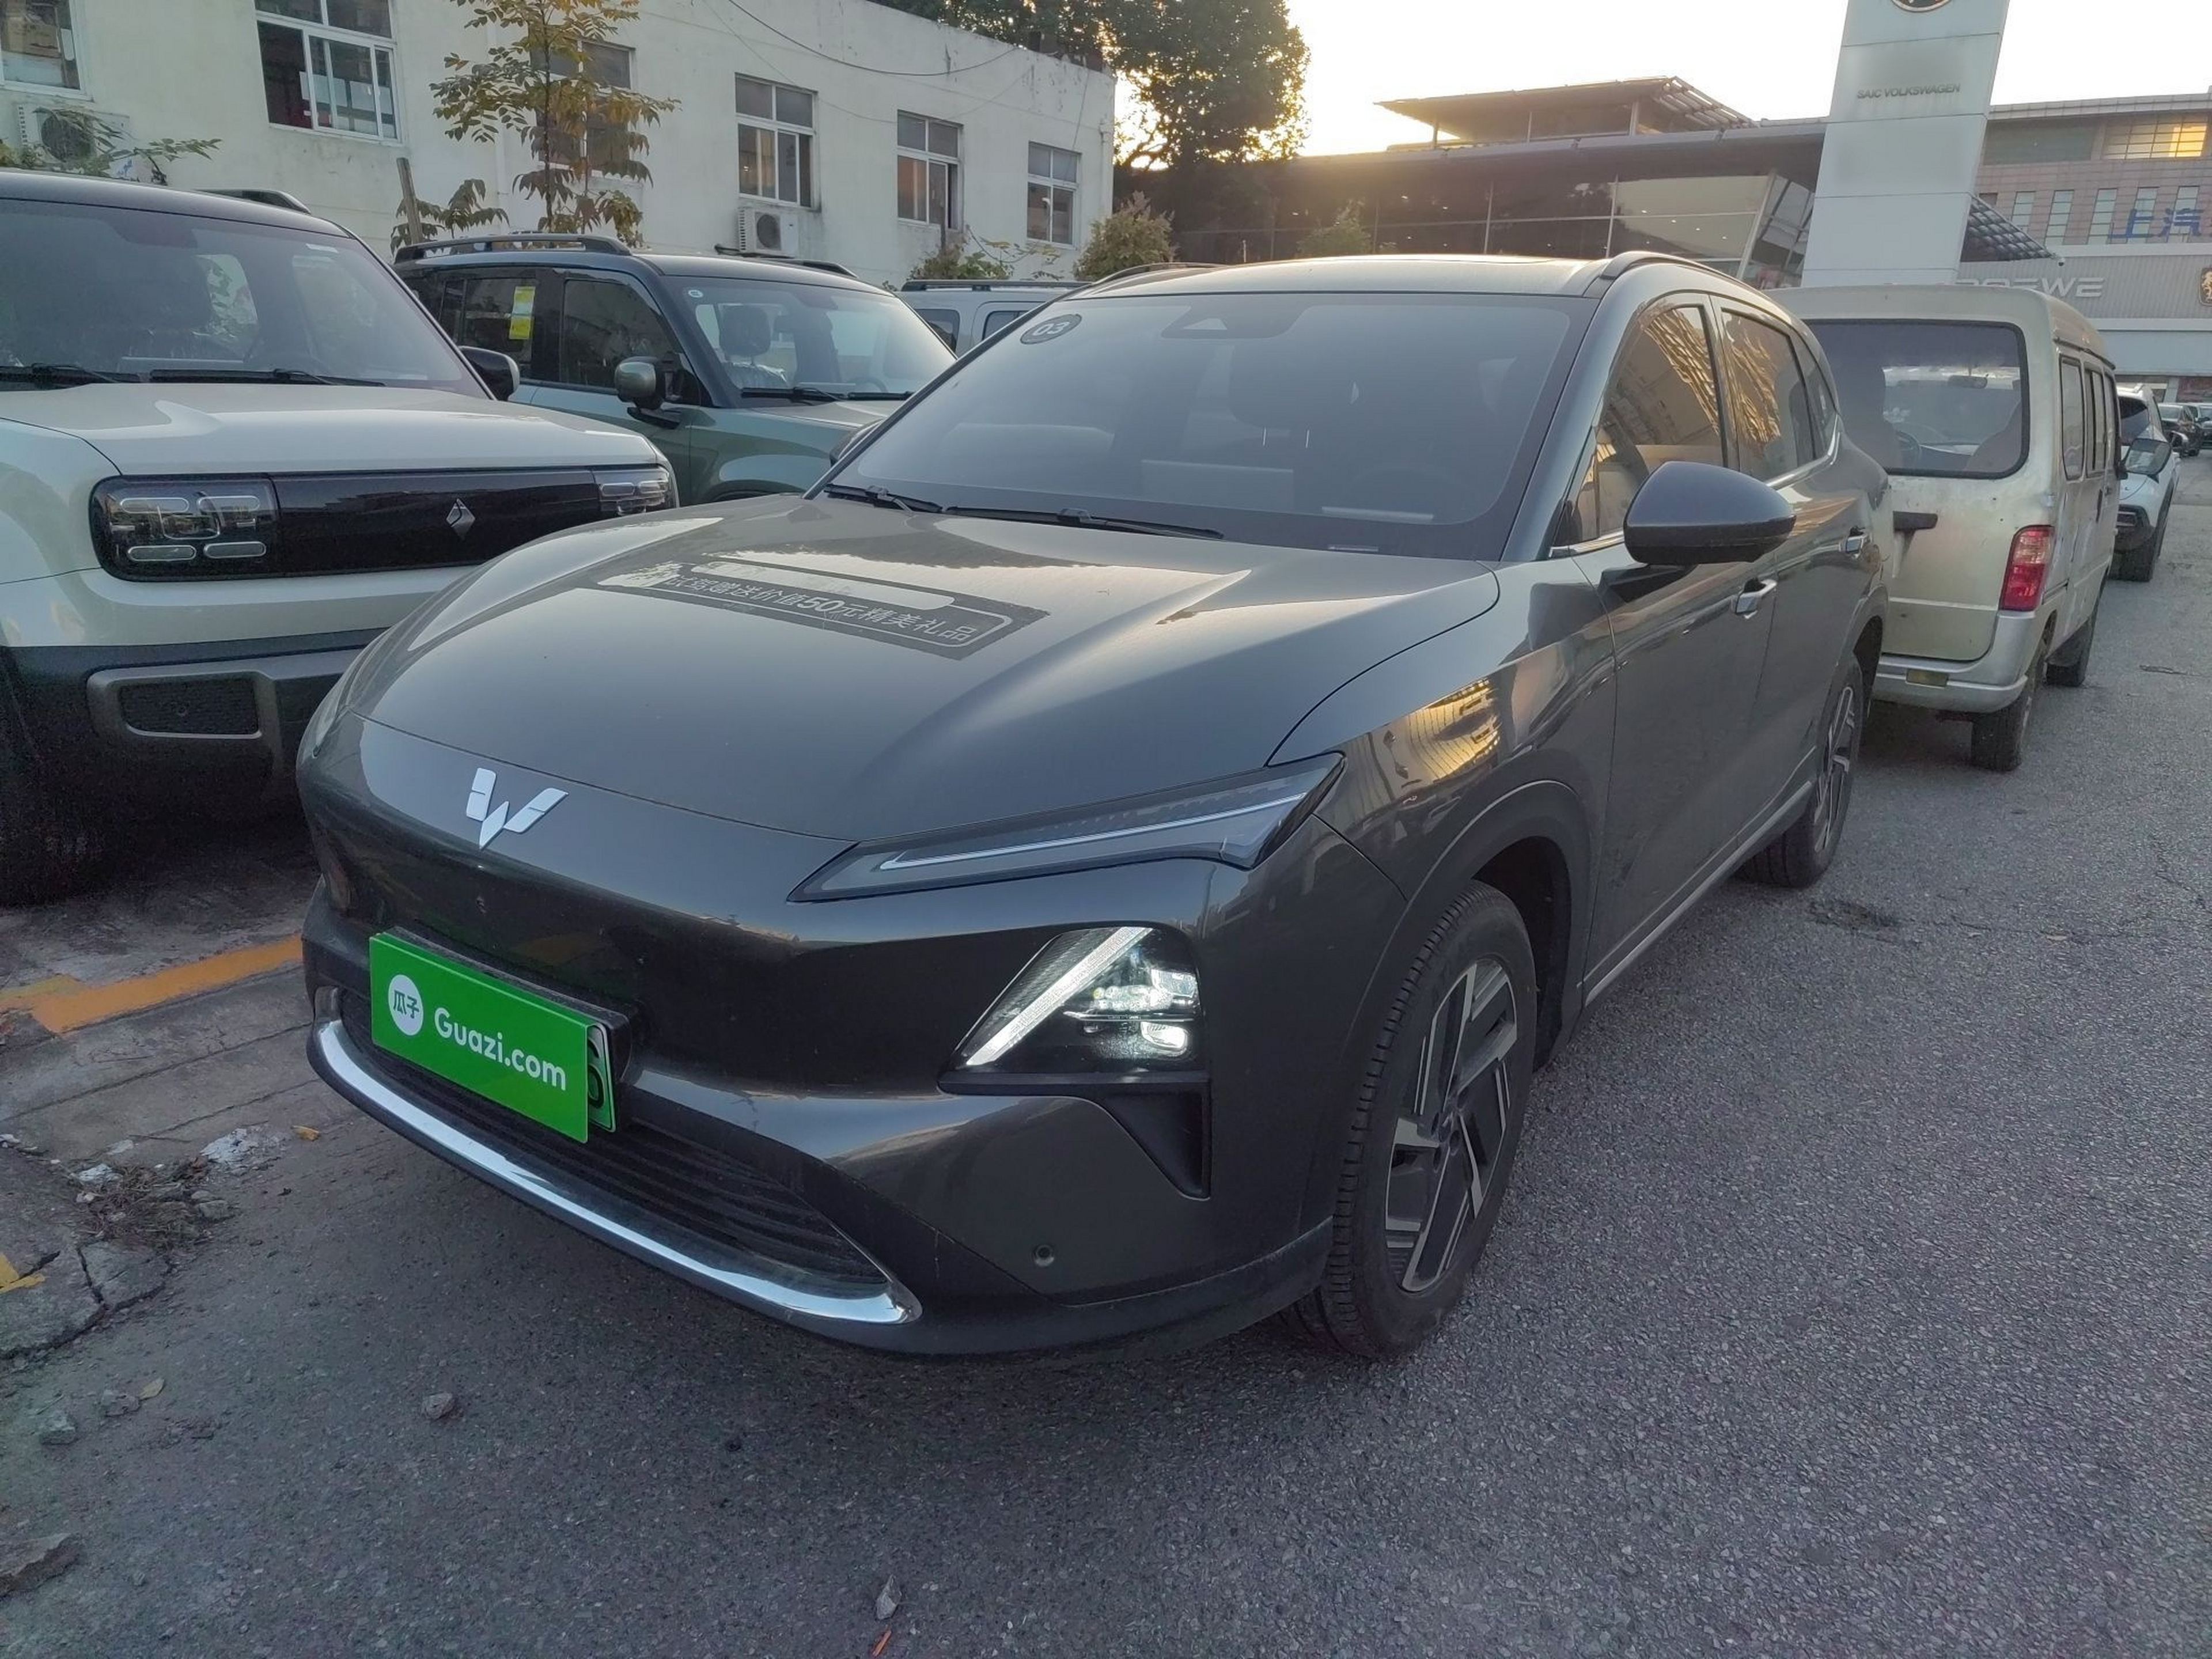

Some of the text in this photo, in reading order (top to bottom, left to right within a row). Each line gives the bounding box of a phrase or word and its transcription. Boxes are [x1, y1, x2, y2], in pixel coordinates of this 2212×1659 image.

[1857, 84, 1961, 99] SAIC VOLKSWAGEN
[2108, 208, 2205, 238] 上汽
[1032, 321, 1070, 336] 03
[393, 988, 420, 1019] 瓜子
[434, 1007, 566, 1091] Guazi.com
